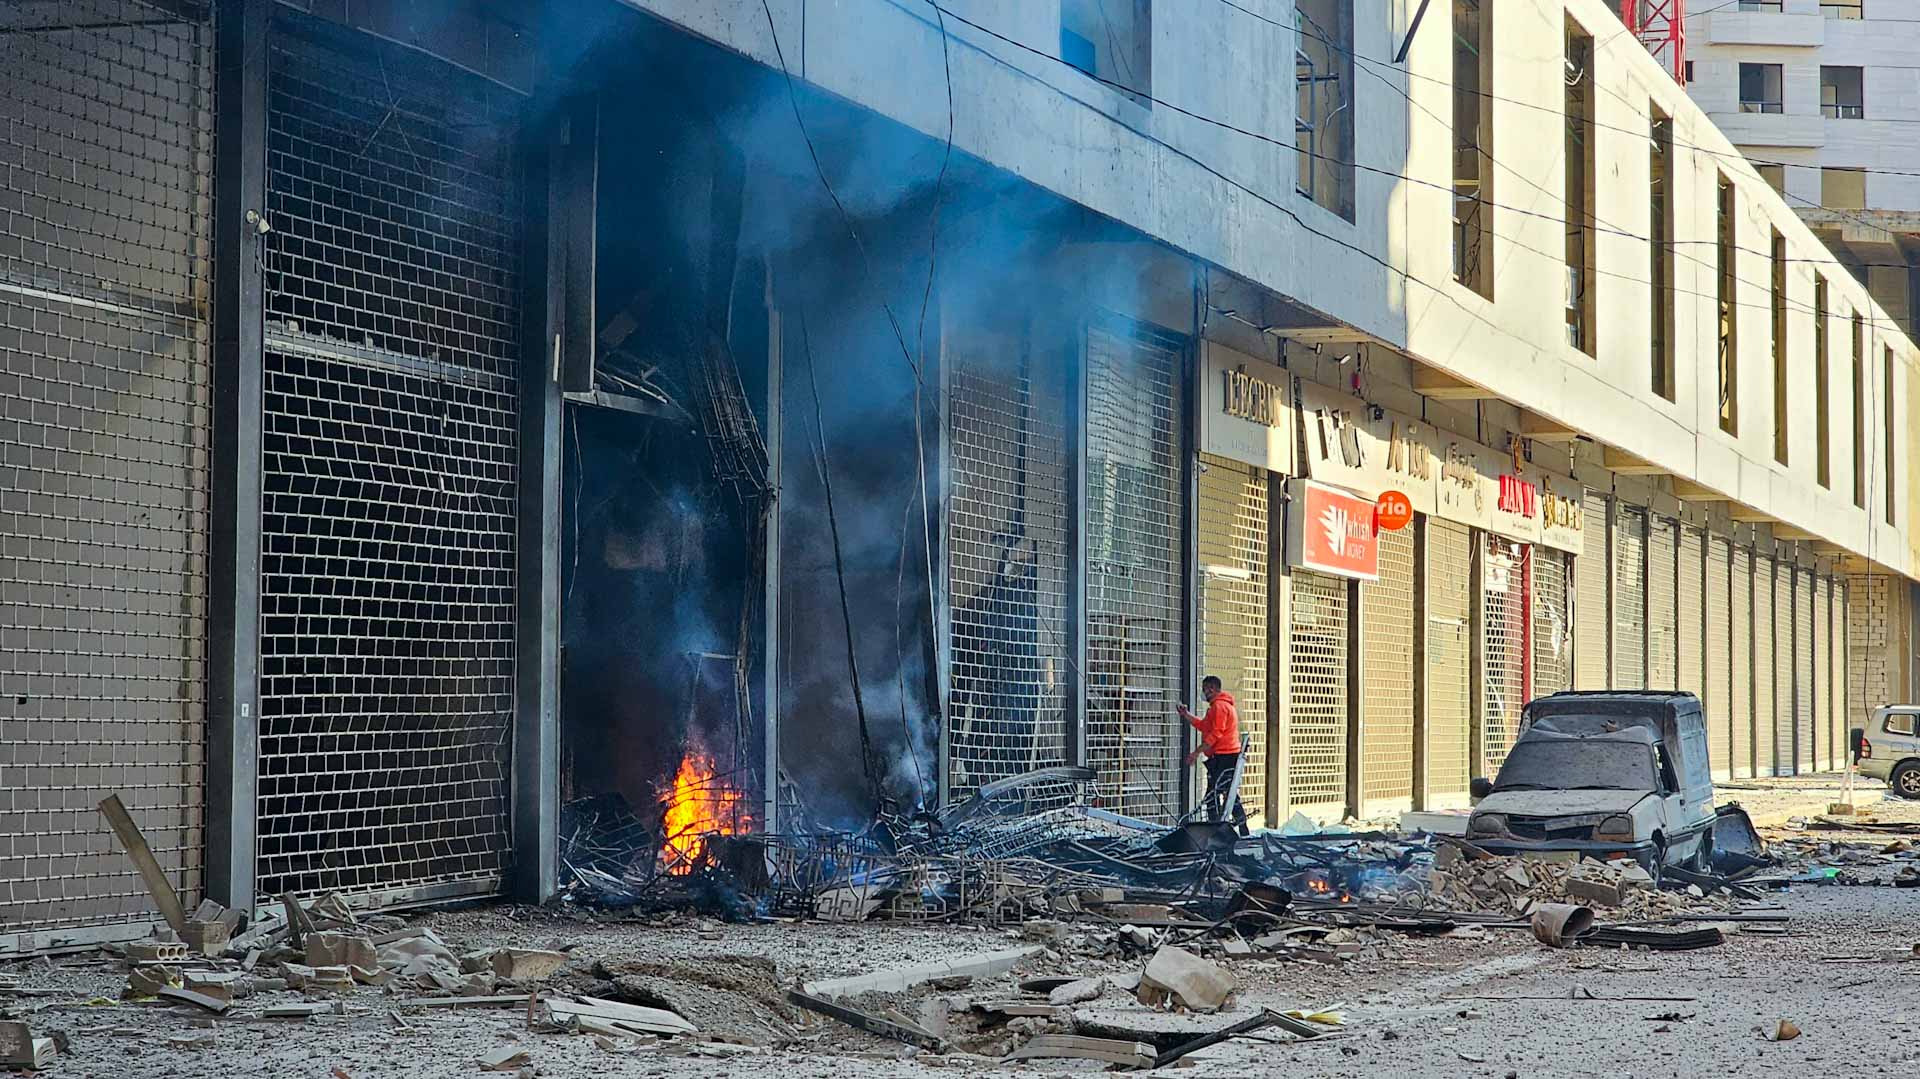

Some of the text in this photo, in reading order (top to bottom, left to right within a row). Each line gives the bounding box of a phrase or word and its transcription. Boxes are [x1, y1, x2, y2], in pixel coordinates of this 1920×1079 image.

[1377, 495, 1406, 515] ria
[1346, 511, 1371, 542] whish
[1346, 543, 1366, 561] MONEY
